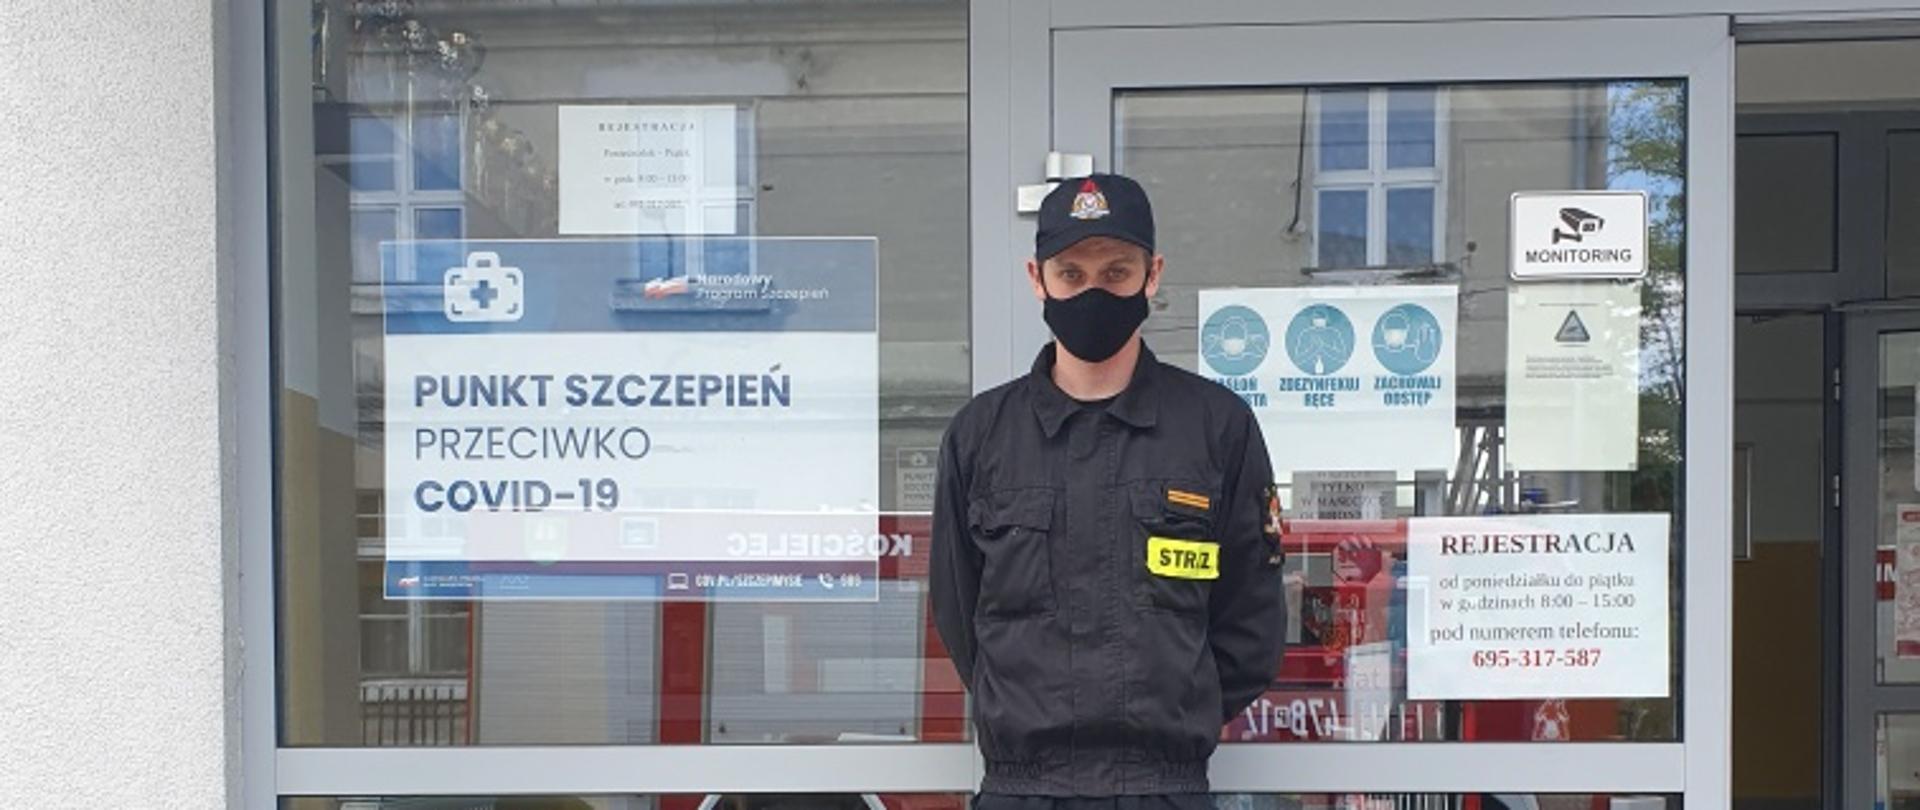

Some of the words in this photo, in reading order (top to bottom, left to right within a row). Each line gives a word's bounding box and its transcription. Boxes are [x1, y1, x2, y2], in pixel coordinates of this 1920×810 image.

[1525, 248, 1632, 263] MONITORING
[698, 272, 773, 289] Narodowy
[414, 374, 554, 407] PUNKT
[564, 363, 791, 408] SZCZEPIEŃ
[1279, 377, 1360, 391] ZDEZYNFEKUJ
[1374, 375, 1441, 390] ZACHOWAJ
[1304, 393, 1335, 409] RĘCE
[1383, 391, 1433, 407] ODSTĘP
[415, 427, 651, 460] PRZECIWKO
[414, 479, 619, 512] COVID-19
[1440, 532, 1636, 556] REJESTRACJA
[1439, 574, 1459, 590] od
[1462, 572, 1561, 592] poniedziałku
[1563, 571, 1583, 588] do
[1588, 571, 1635, 589] piątku
[1440, 599, 1453, 610] w
[1457, 594, 1536, 613] godzinach
[1540, 593, 1574, 609] 8:00
[1592, 592, 1636, 608] 15:00
[1430, 623, 1465, 646] pod
[1470, 625, 1554, 641] numerem
[1559, 621, 1640, 640] telefonu:
[1471, 648, 1602, 668] 695-317-587
